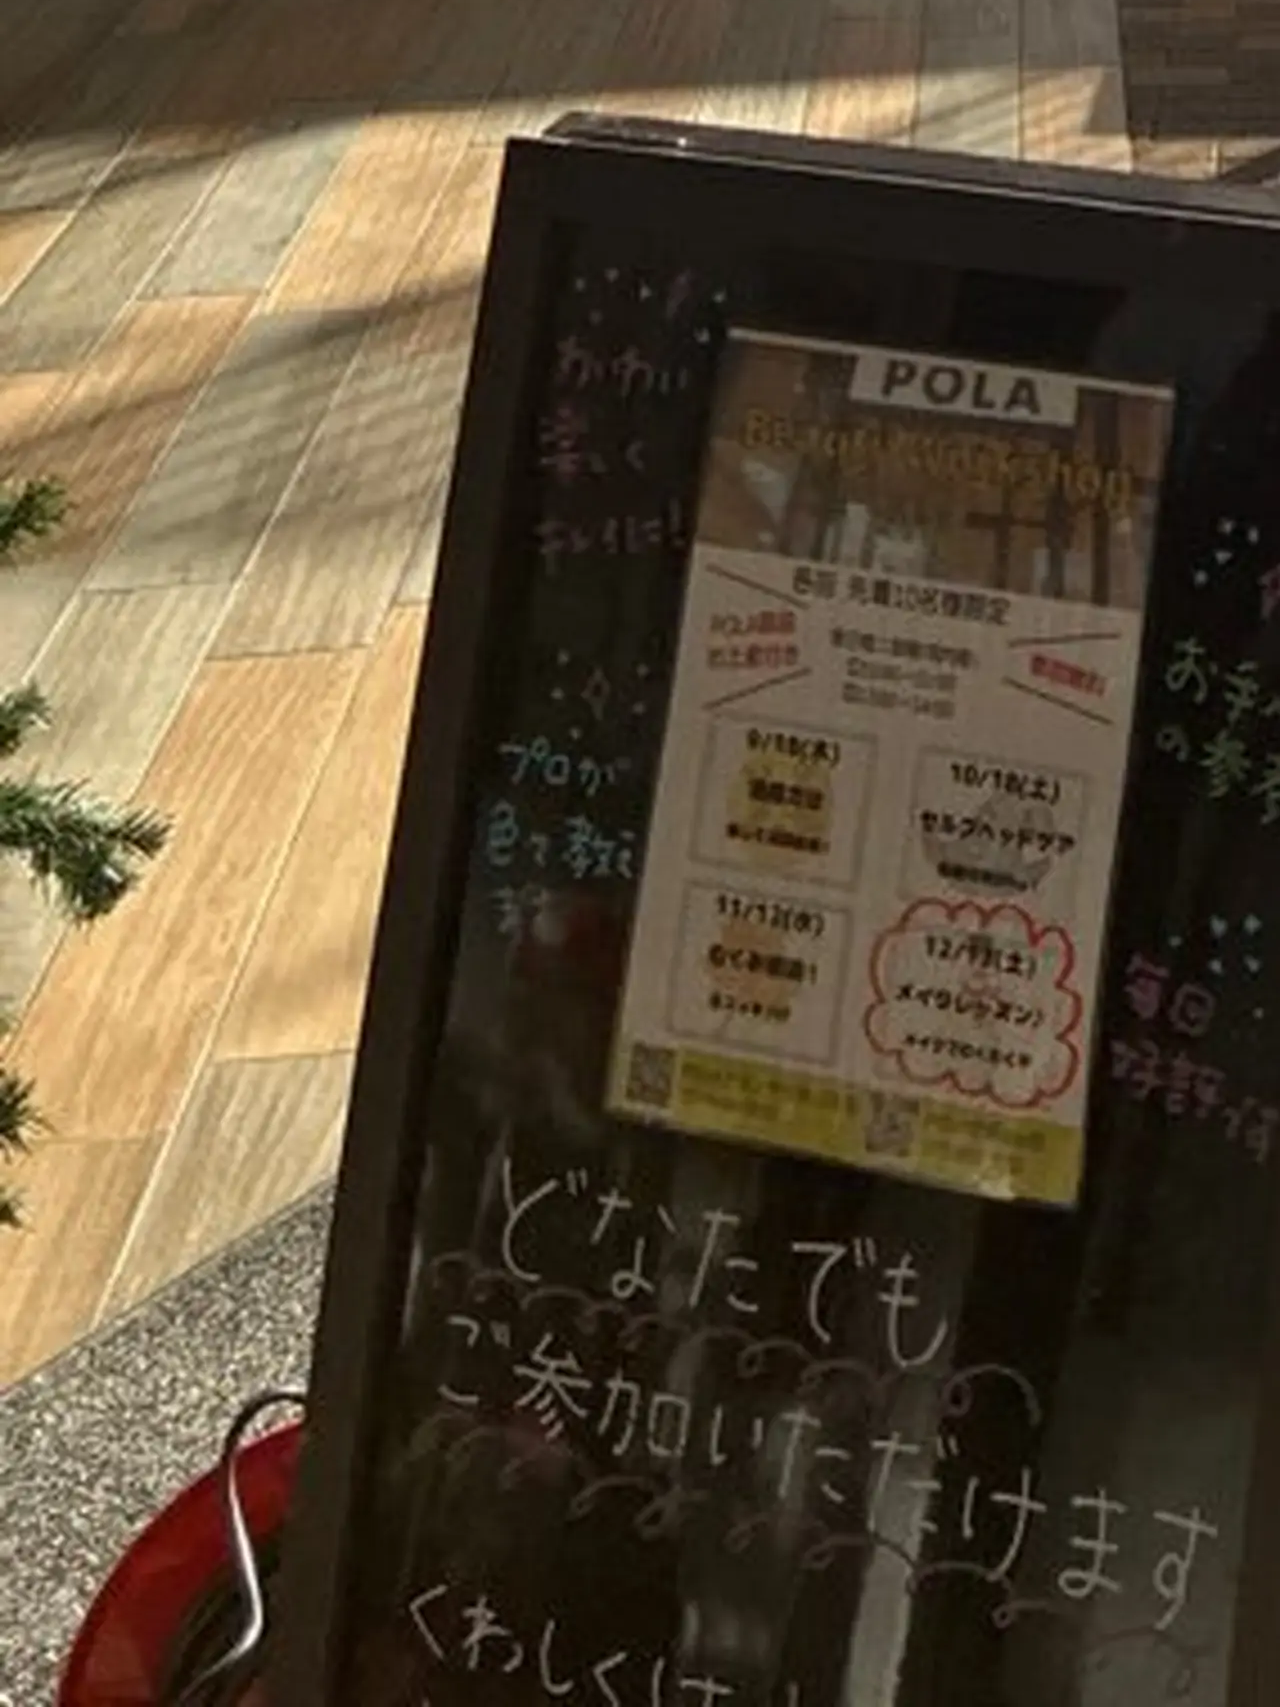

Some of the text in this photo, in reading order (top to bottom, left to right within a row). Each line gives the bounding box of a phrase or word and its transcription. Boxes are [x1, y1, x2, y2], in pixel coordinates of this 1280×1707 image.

[879, 358, 1043, 416] POLA
[498, 1152, 951, 1368] どなたでも
[436, 1313, 1220, 1633] ご参加いただけます
